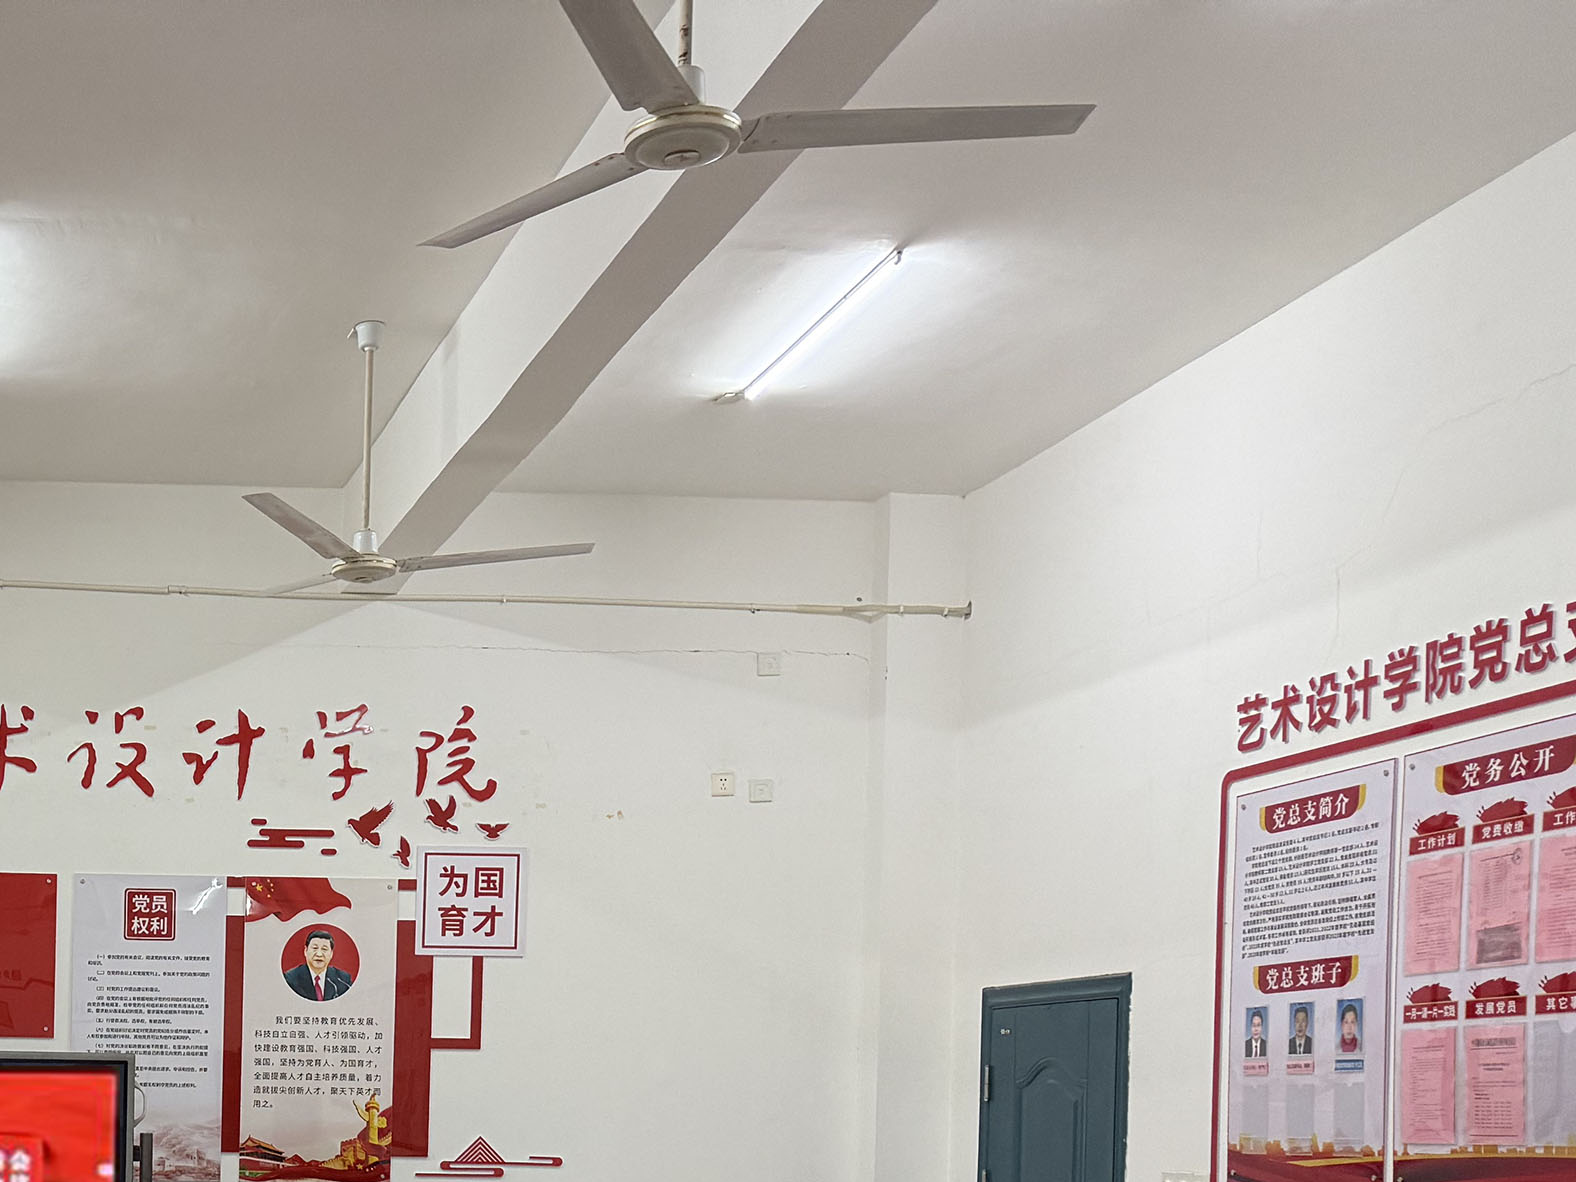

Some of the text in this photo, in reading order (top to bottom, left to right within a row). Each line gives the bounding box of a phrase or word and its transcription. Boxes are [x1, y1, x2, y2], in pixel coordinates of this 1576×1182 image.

[1236, 600, 1576, 753] 艺术设计学院党总
[1461, 745, 1555, 790] 党务公开
[1272, 793, 1350, 830] 党总支简介
[1417, 832, 1457, 850] 工作计划
[1266, 962, 1342, 990] 党总支班子
[1475, 1000, 1517, 1016] 发展党员
